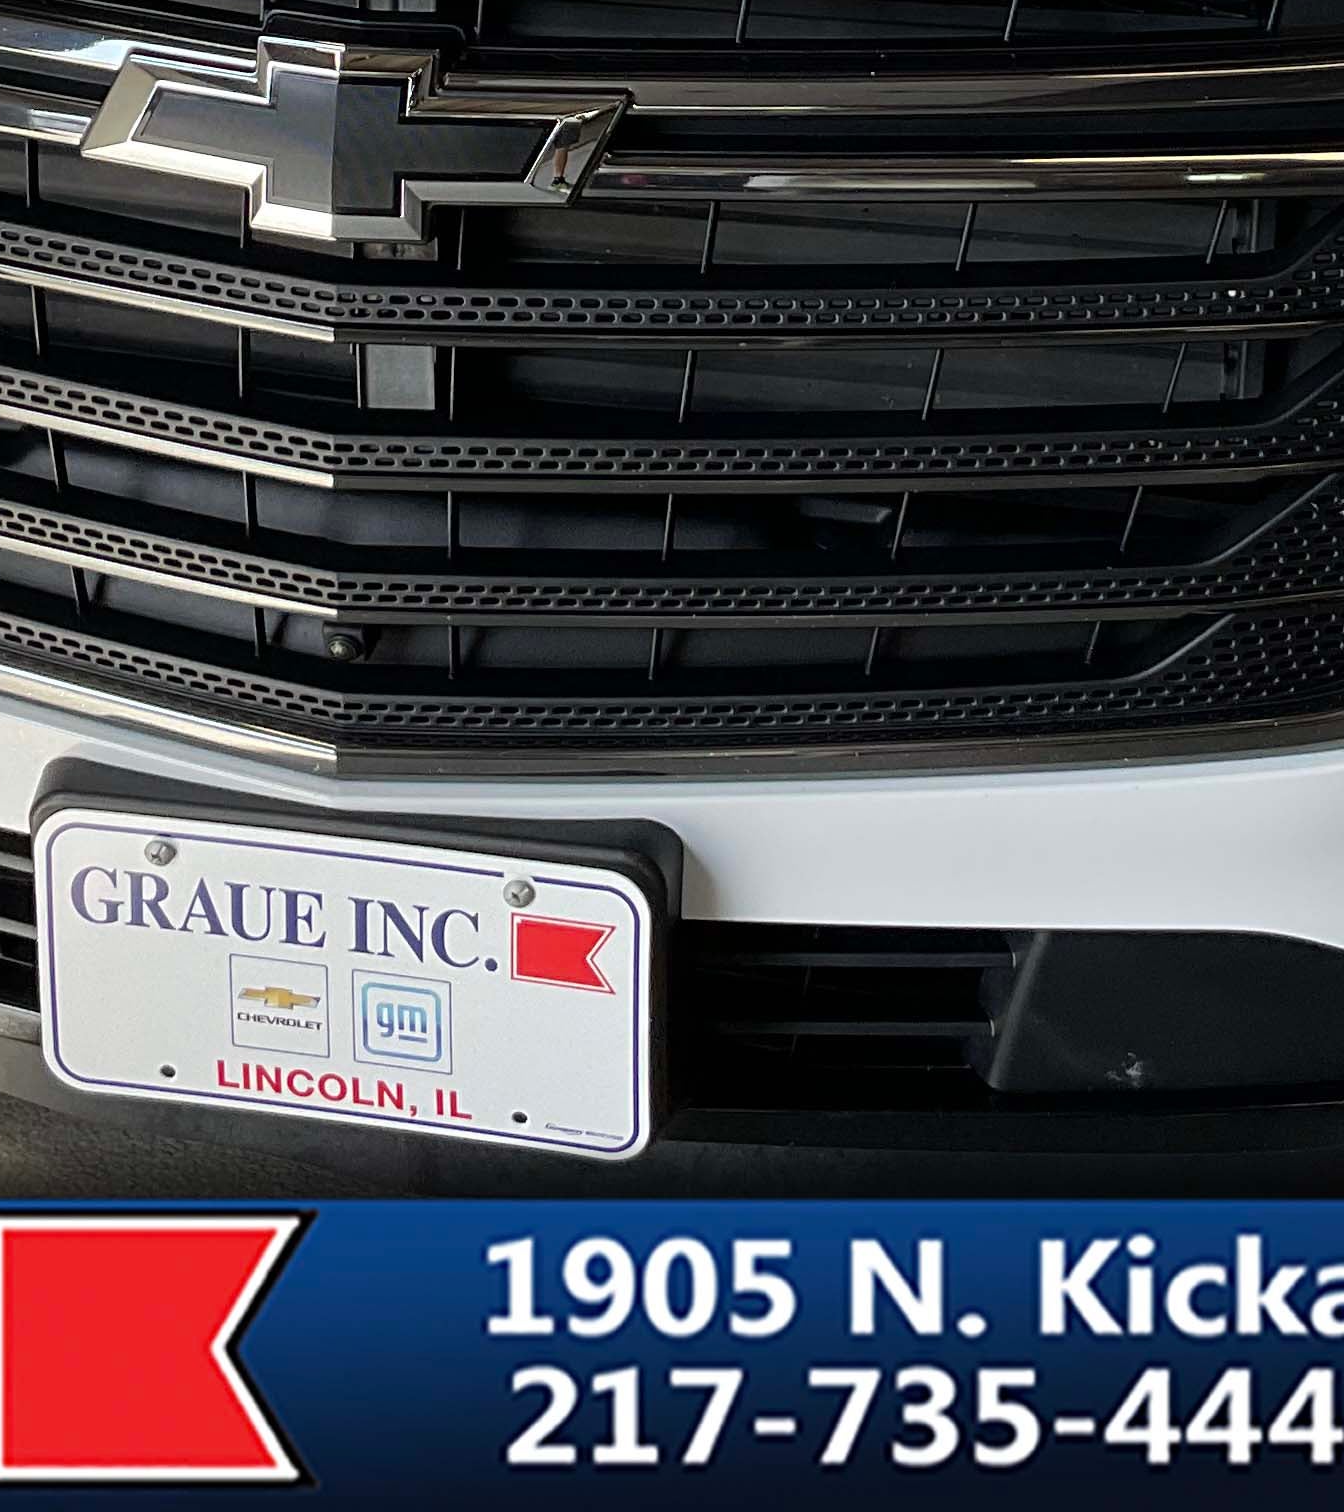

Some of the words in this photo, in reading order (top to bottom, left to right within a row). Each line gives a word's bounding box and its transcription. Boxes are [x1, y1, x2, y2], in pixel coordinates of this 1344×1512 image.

[70, 865, 327, 948] GRAUE
[347, 896, 500, 972] INC.
[237, 1011, 323, 1031] CHEVROLET
[216, 1059, 419, 1118] LINCOLN,
[435, 1089, 473, 1121] IL
